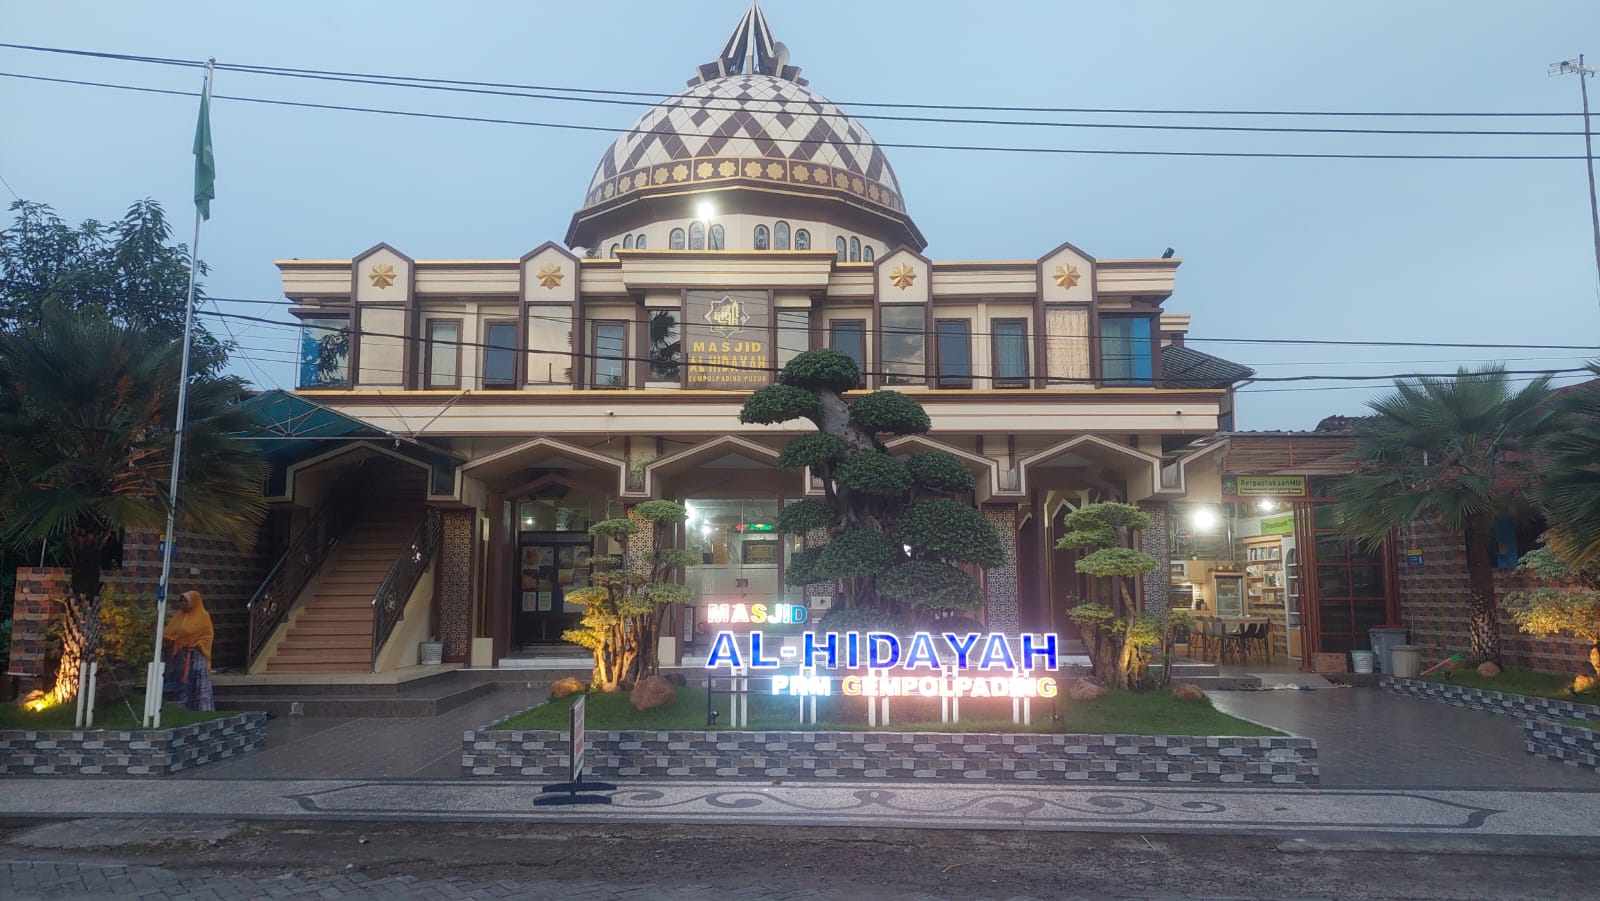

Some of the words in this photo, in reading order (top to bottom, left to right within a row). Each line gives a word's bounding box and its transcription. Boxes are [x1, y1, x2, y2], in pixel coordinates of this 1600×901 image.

[693, 342, 761, 353] MASJID
[690, 355, 705, 373] AL
[708, 355, 766, 374] HIDAYAH
[707, 603, 807, 624] MASJID
[705, 630, 1059, 671] AL-HIDAYAH
[772, 675, 831, 696] PRM
[842, 675, 1058, 697] GEMPOLPADING
